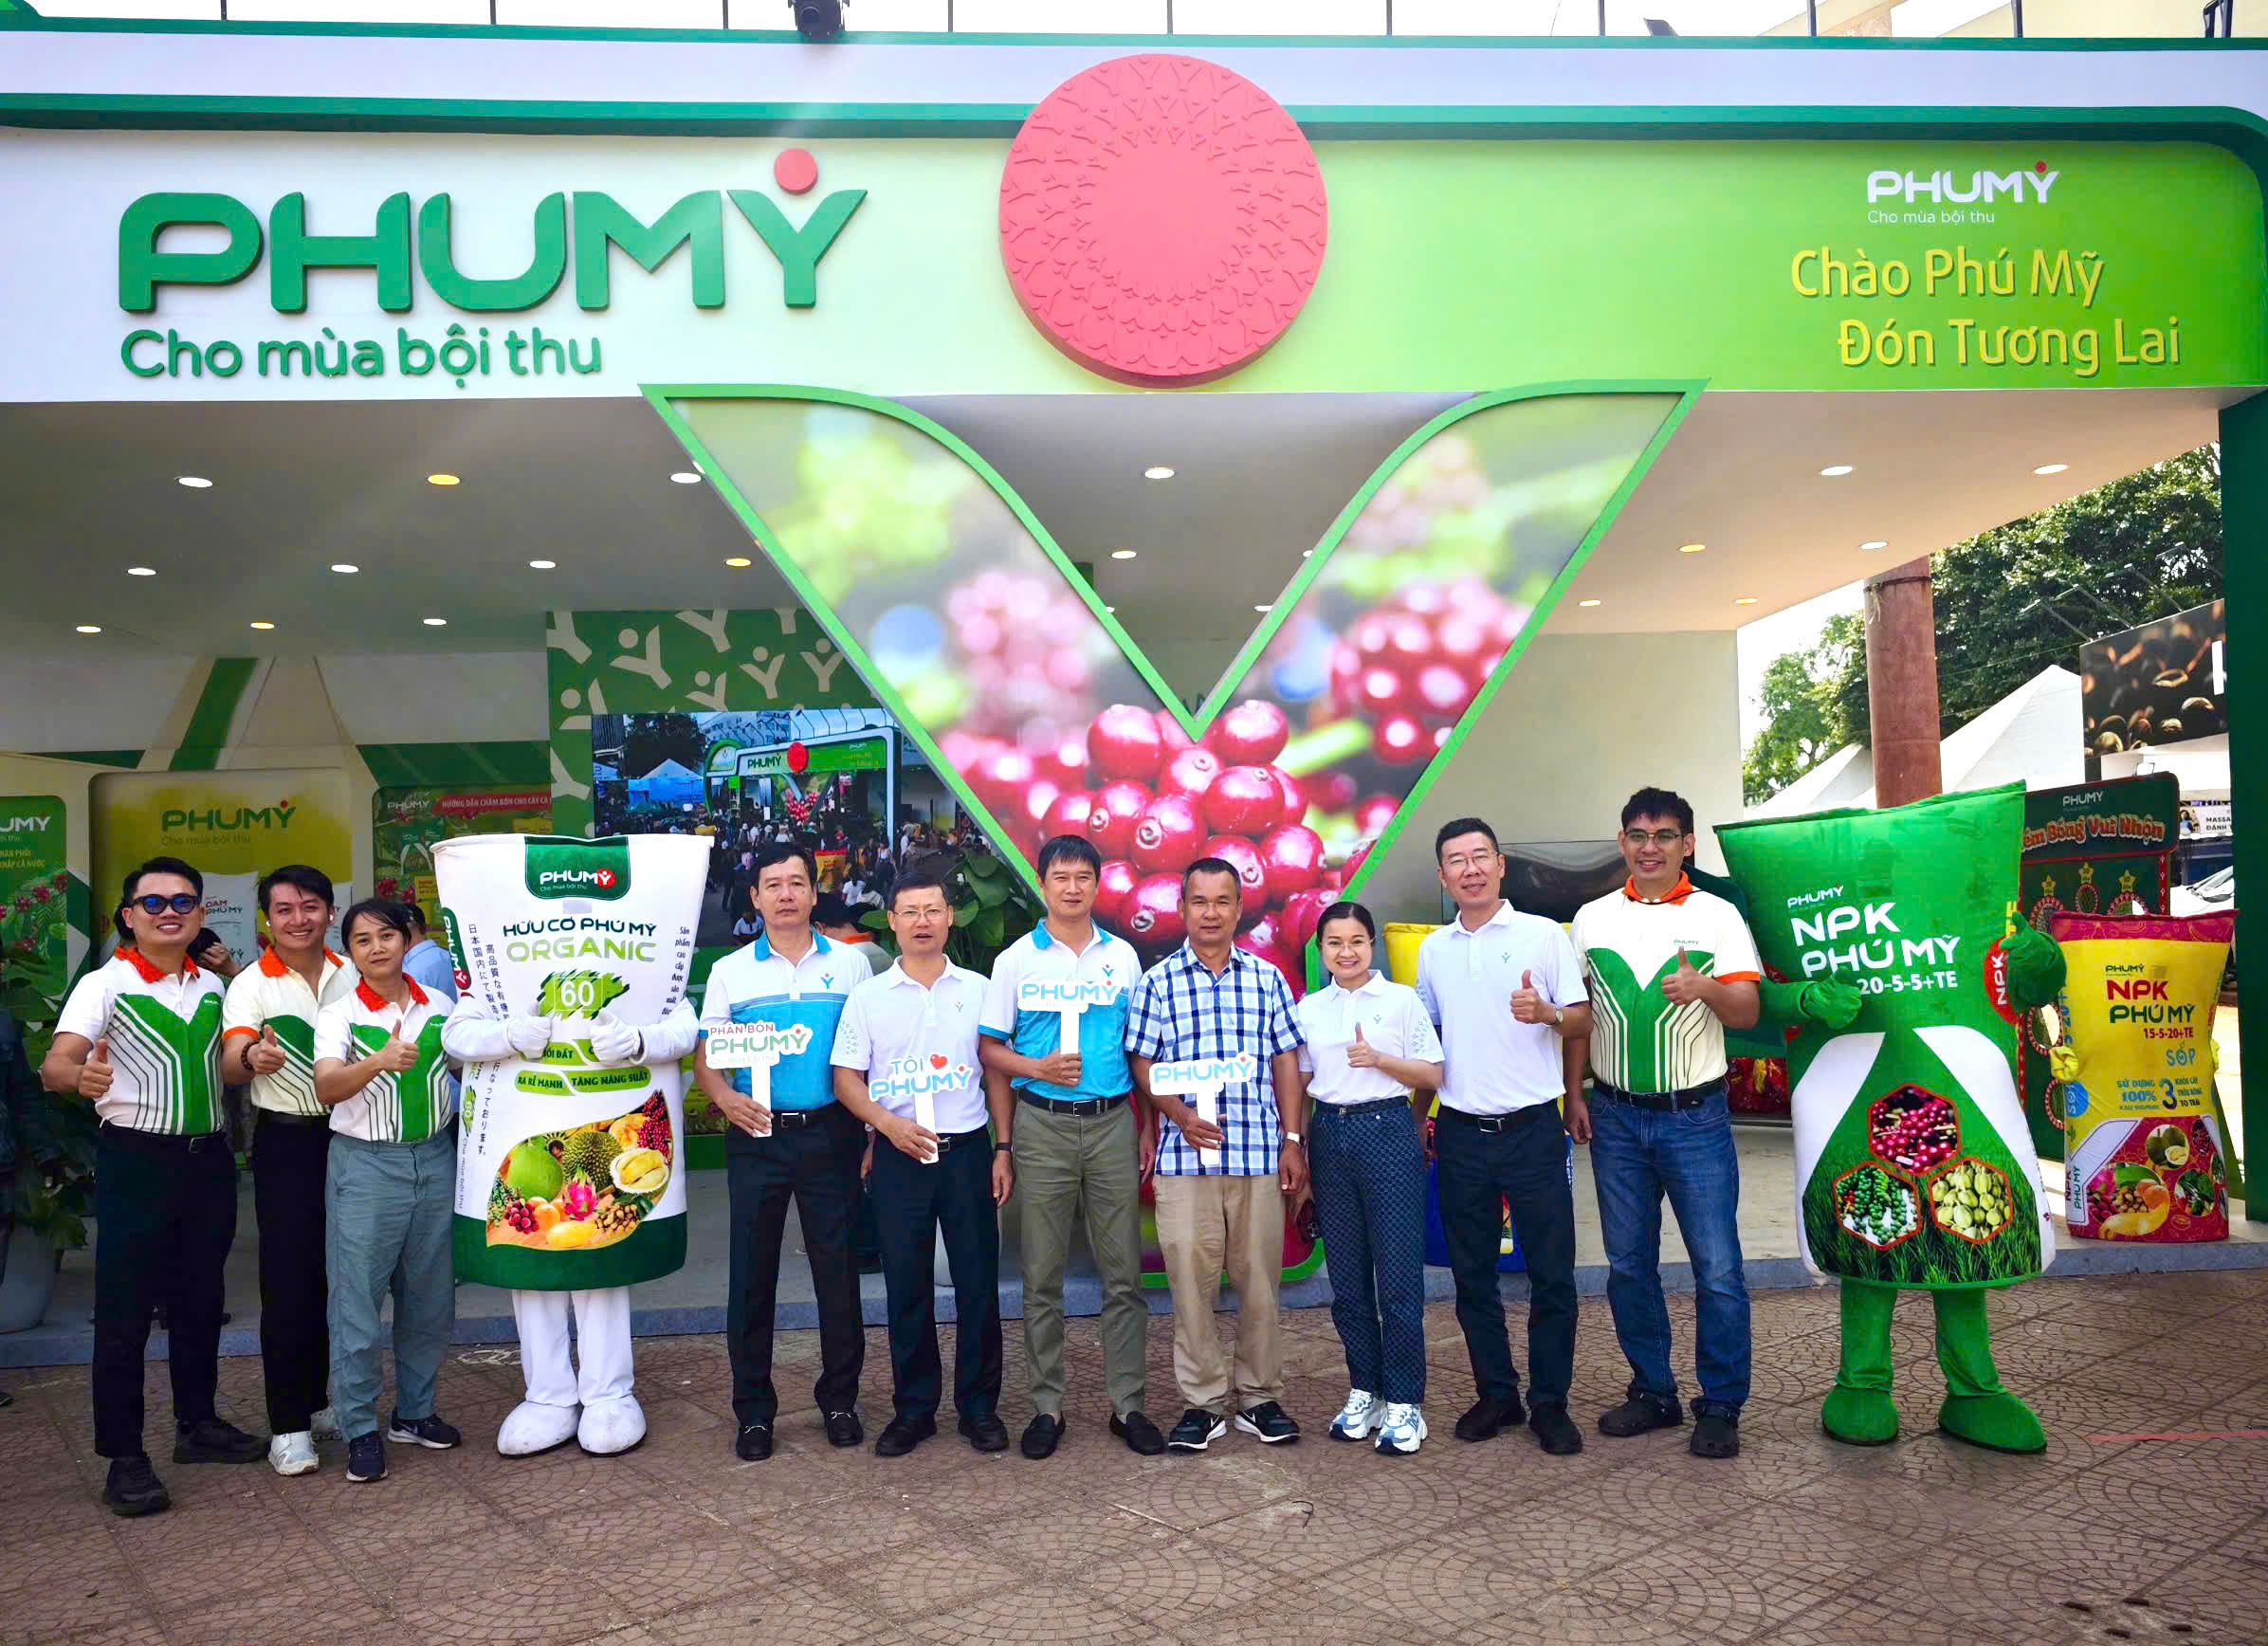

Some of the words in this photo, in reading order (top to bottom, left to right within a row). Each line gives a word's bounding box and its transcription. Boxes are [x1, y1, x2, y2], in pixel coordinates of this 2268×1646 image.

[1867, 210, 1898, 225] Cho
[1903, 210, 1936, 224] mùa
[1941, 210, 1966, 226] bội
[1969, 210, 1996, 224] thu
[1791, 246, 1912, 298] Chào
[1925, 246, 2017, 297] Phú
[2030, 249, 2106, 309] Mỹ
[119, 327, 244, 378] Cho
[258, 325, 383, 377] mùa
[397, 322, 491, 388] bội
[507, 327, 603, 375] thu
[1838, 318, 1936, 368] Đón
[1948, 320, 2100, 379] Tương
[2114, 316, 2183, 366] Lai
[514, 796, 527, 805] CHO
[2022, 827, 2046, 849] ém
[2047, 817, 2086, 843] Bóng
[2088, 815, 2117, 836] Vui
[503, 920, 544, 937] HỮU
[547, 916, 576, 932] CƠ
[580, 917, 626, 932] PHÚ
[629, 922, 657, 937] MỸ
[1790, 902, 1901, 946] NPK
[505, 936, 657, 962] ORGANIC
[1802, 939, 1894, 978] PHÚ
[1901, 934, 1961, 966] MỸ
[1856, 971, 1958, 996] 20-5-5+TE
[1991, 952, 2007, 1005] NPK
[2106, 978, 2169, 1001] NPK
[560, 980, 595, 1009] 60
[2109, 1003, 2165, 1024] PHÚ
[2167, 1003, 2196, 1024] MỸ
[710, 1023, 743, 1035] PHÂN
[747, 1020, 774, 1033] BÓN
[2143, 1027, 2194, 1039] 15-5-20+TE
[556, 1048, 574, 1059] ĐẤT
[889, 1055, 924, 1075] TÔI
[518, 1076, 526, 1085] RA
[538, 1078, 563, 1089] MẠNH
[571, 1075, 598, 1087] TĂNG
[601, 1073, 627, 1085] NĂNG
[629, 1071, 649, 1082] SUẤT
[2121, 1090, 2157, 1102] 100%
[2159, 1078, 2178, 1109] 3
